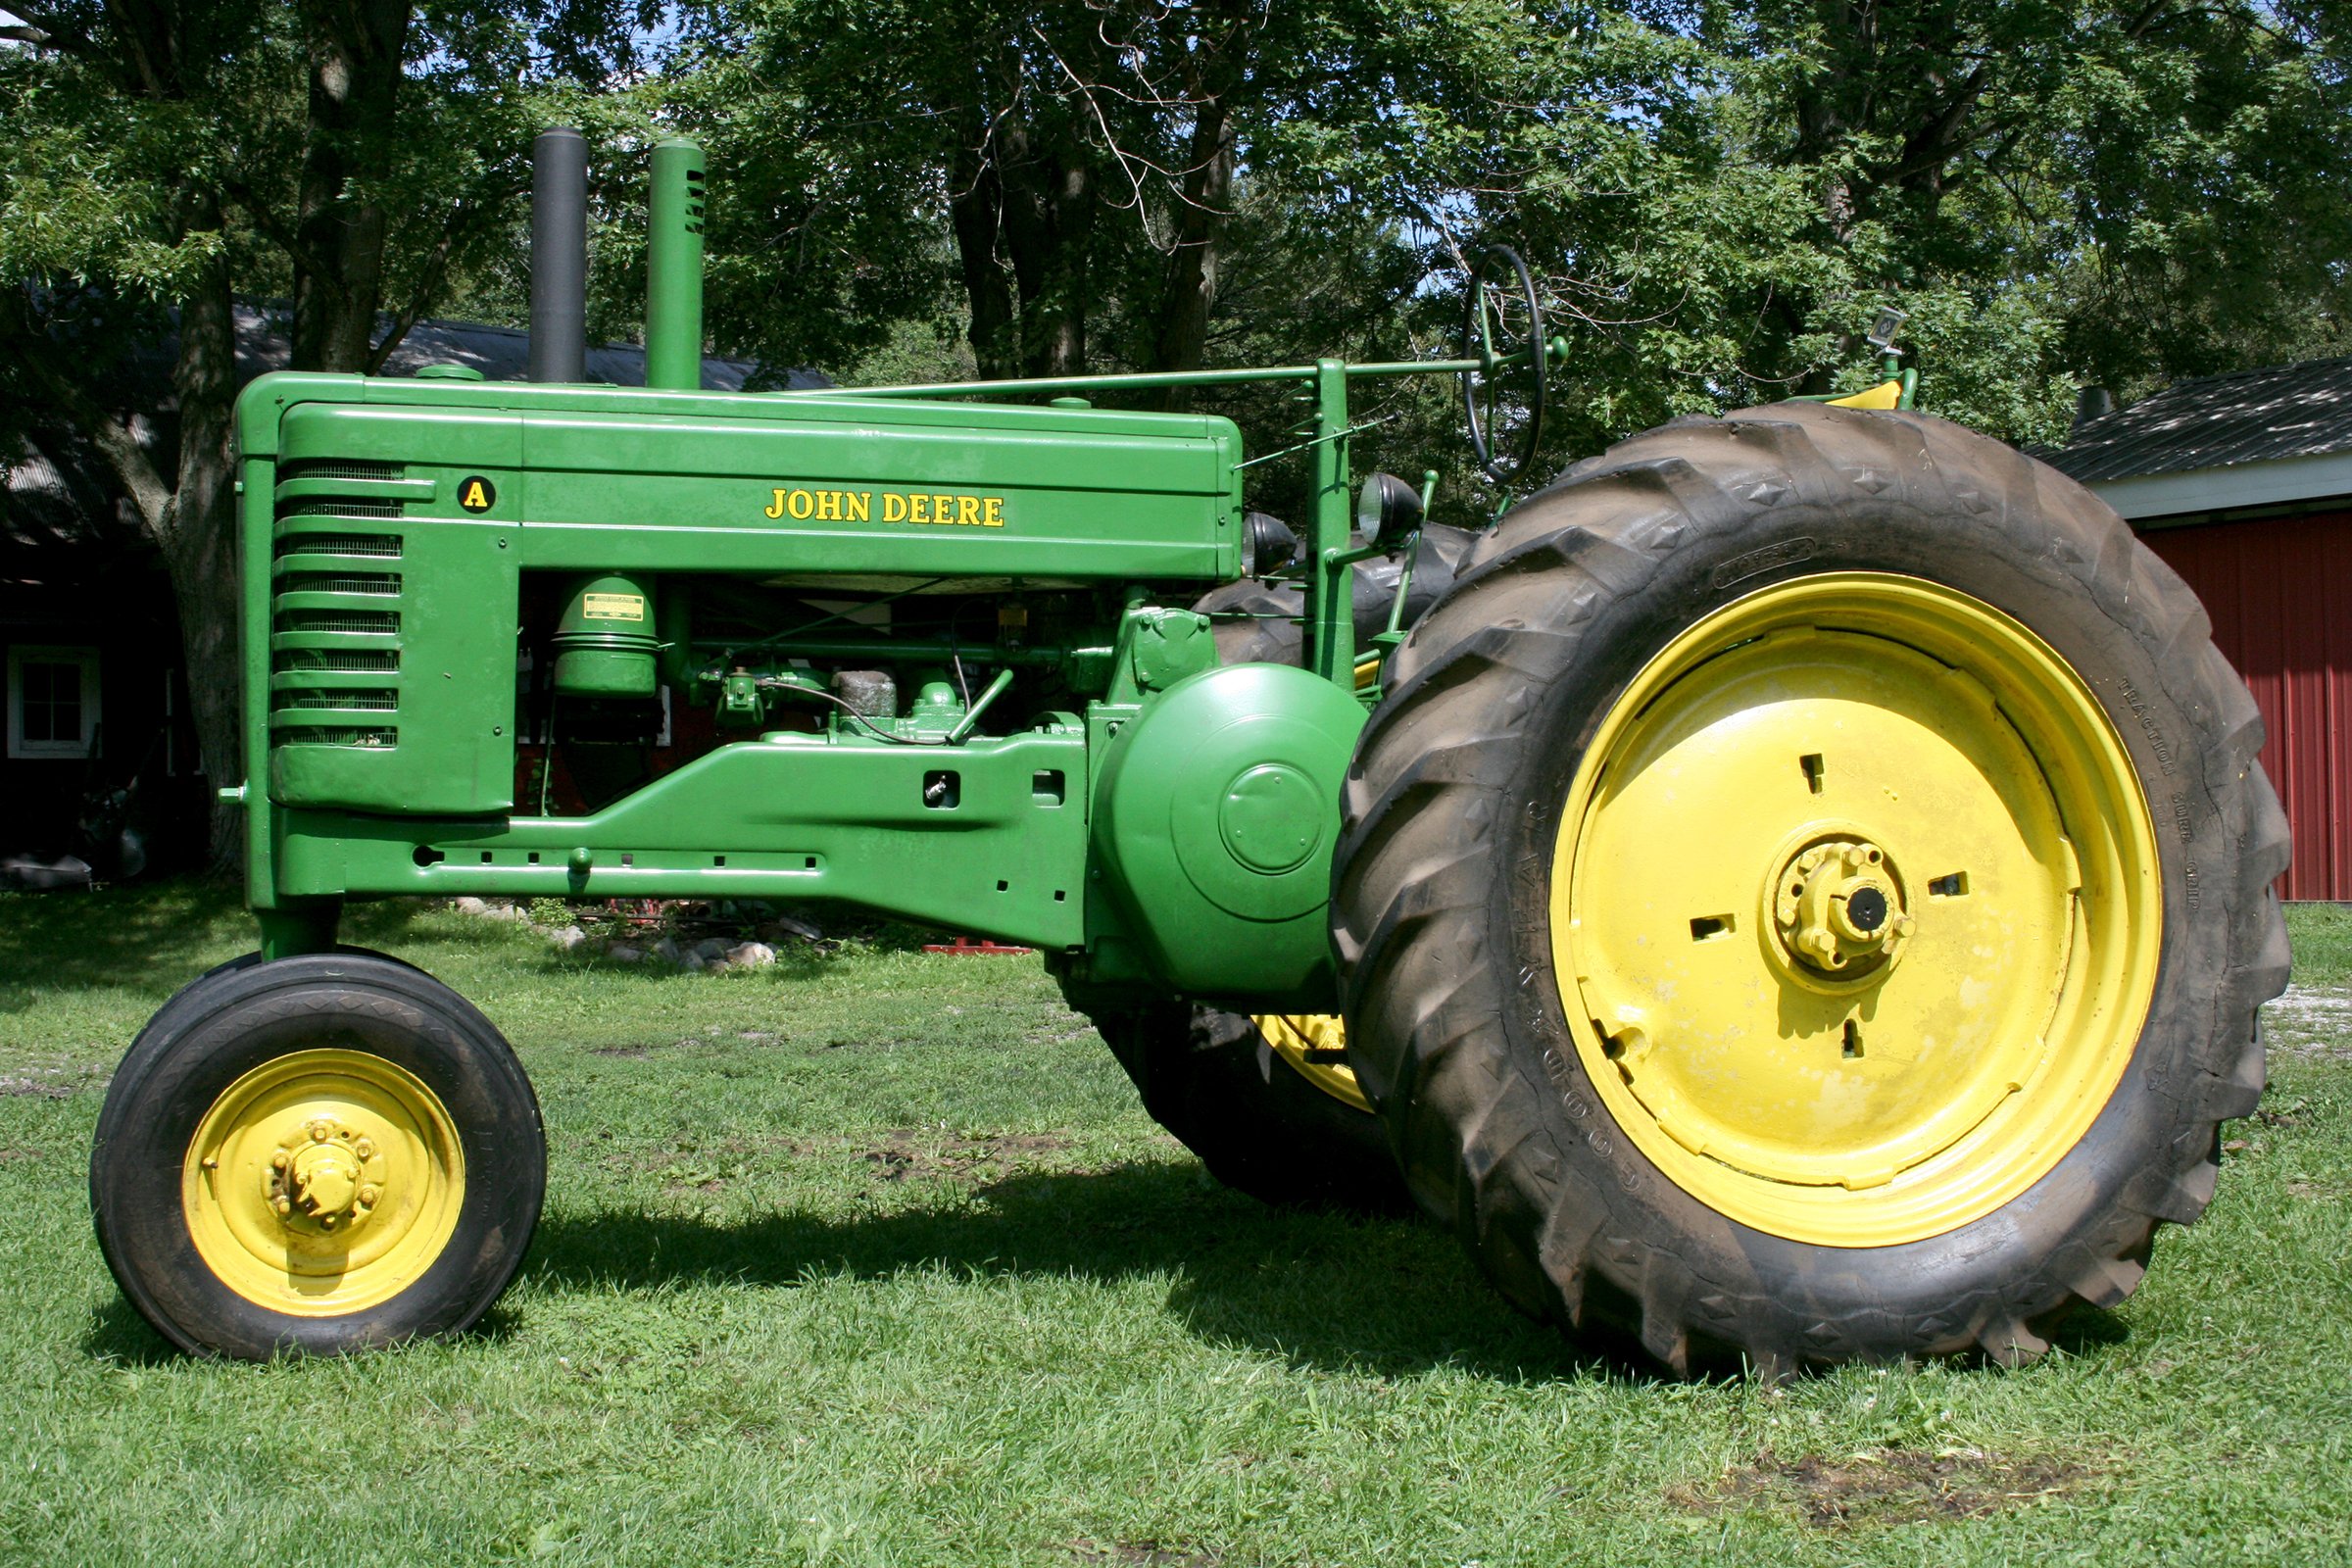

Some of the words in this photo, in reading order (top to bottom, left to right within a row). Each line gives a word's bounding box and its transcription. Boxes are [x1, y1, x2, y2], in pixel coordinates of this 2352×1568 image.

[464, 481, 488, 508] A
[764, 489, 871, 522] JOHN
[882, 493, 1004, 527] DEERE
[2118, 677, 2176, 777] TRACTION
[2185, 860, 2201, 911] GRIP
